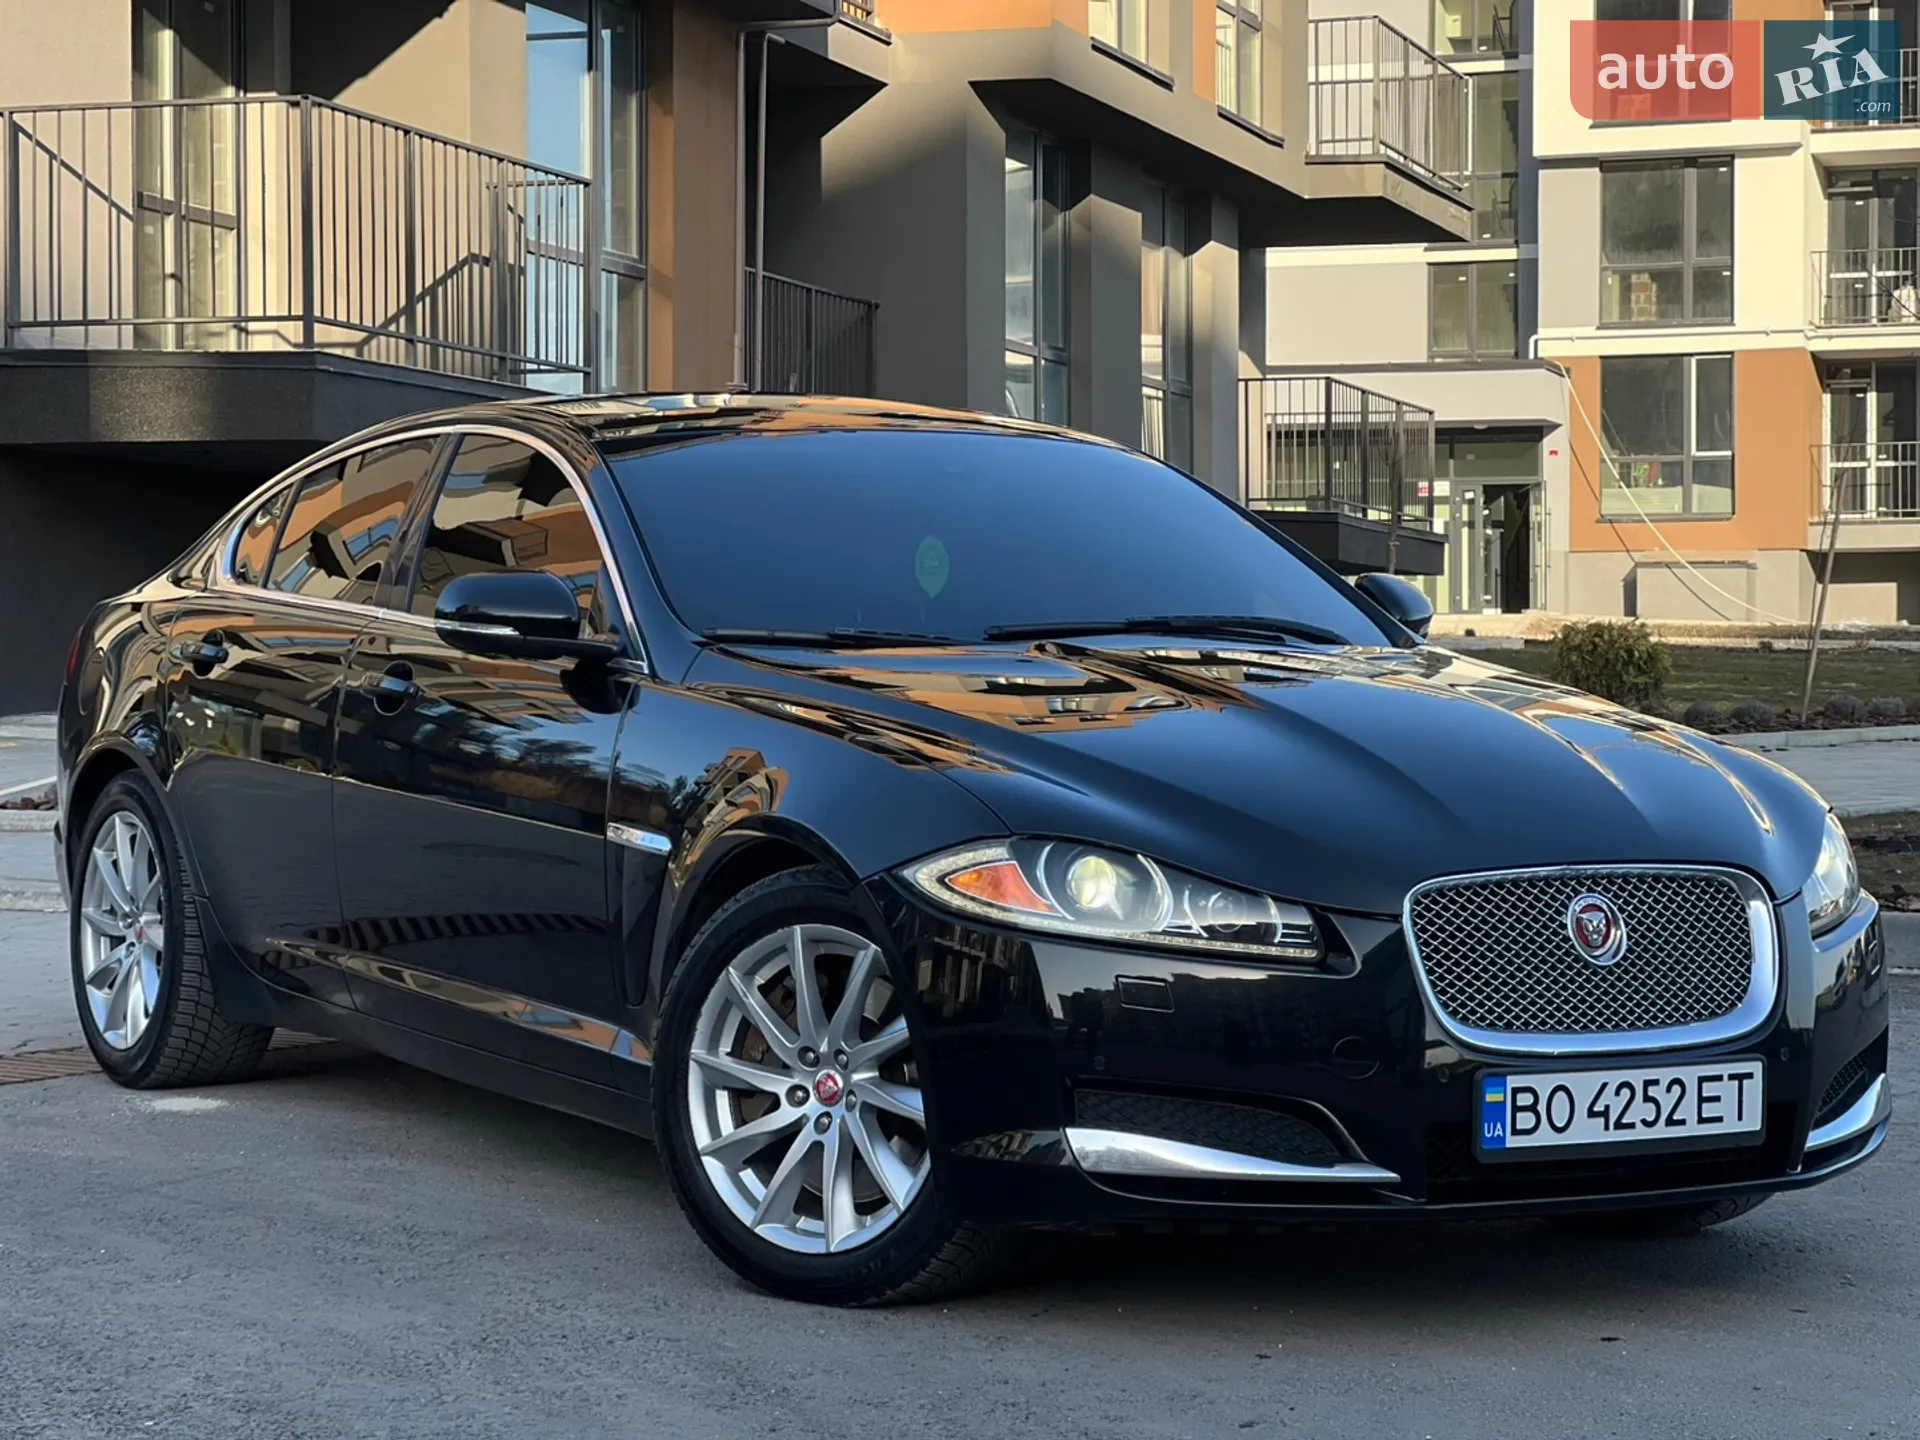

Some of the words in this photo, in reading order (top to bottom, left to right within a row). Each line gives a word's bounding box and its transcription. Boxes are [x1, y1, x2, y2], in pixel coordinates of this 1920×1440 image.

[1510, 1084, 1576, 1136] BO
[1586, 1077, 1687, 1131] 4252
[1697, 1072, 1754, 1125] ET
[1484, 1122, 1503, 1138] UA
